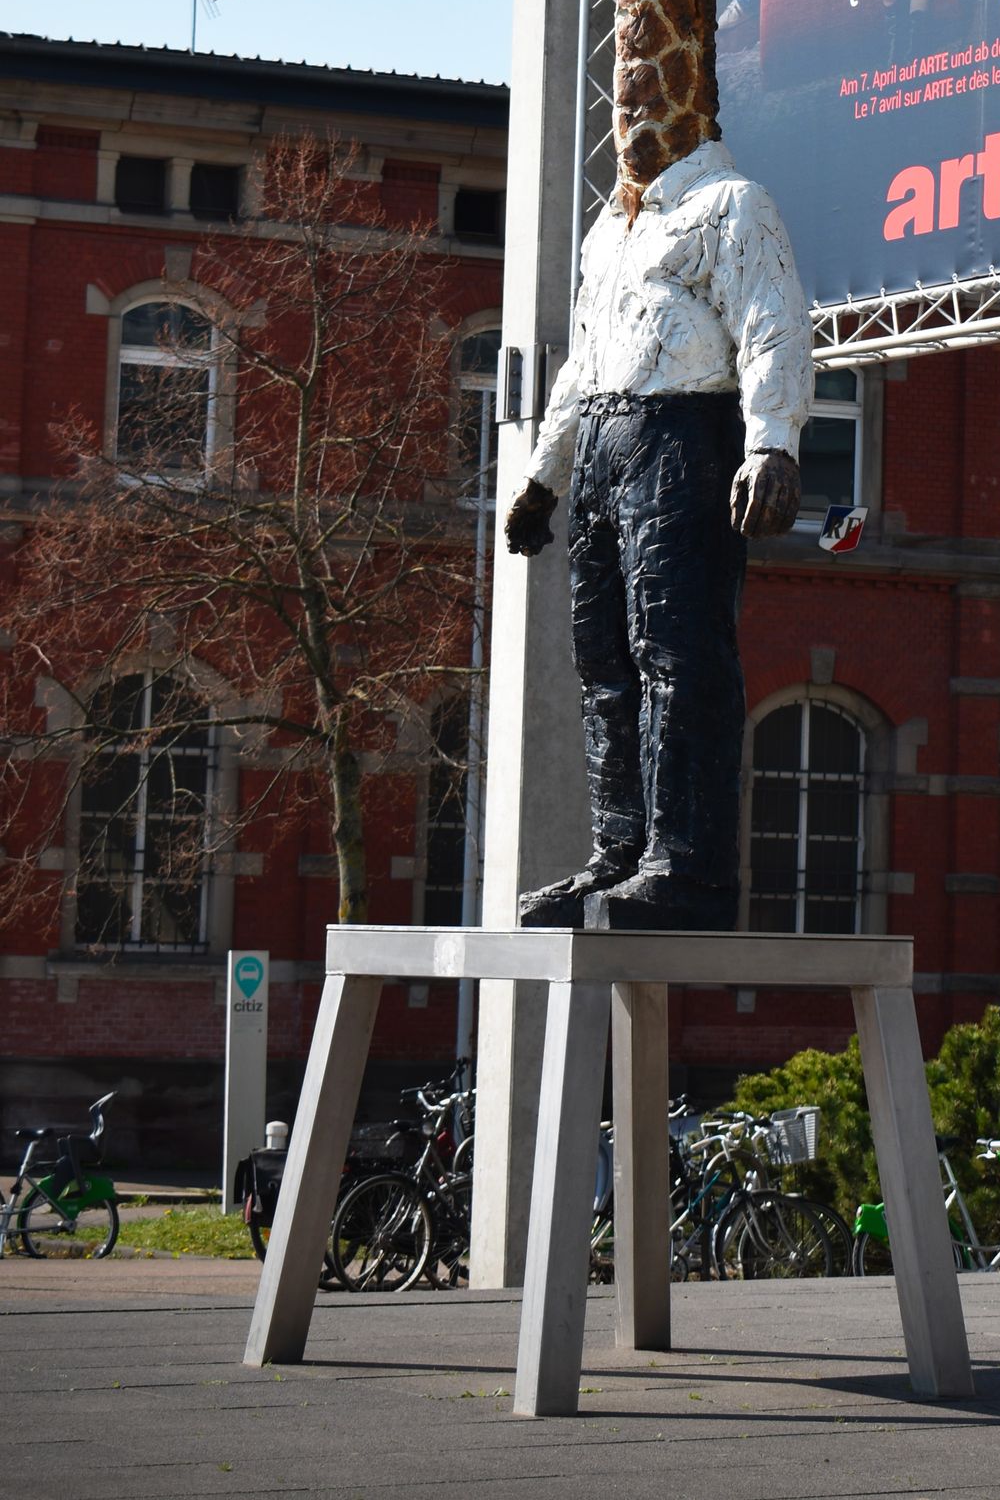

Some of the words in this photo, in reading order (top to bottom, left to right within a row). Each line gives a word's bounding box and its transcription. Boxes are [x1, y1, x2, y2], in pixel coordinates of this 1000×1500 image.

[840, 77, 859, 97] Am
[861, 73, 871, 92] 7.
[872, 64, 898, 94] April
[899, 61, 918, 82] auf
[918, 52, 950, 78] ARTE
[950, 45, 973, 69] und
[974, 41, 990, 62] ab
[854, 100, 868, 120] Le
[870, 97, 878, 115] 7
[879, 89, 902, 113] avril
[903, 90, 923, 108] sur
[923, 77, 954, 103] ARTE
[955, 75, 968, 95] et
[968, 68, 990, 91] dès
[825, 515, 862, 540] RF
[234, 999, 264, 1012] citiz
